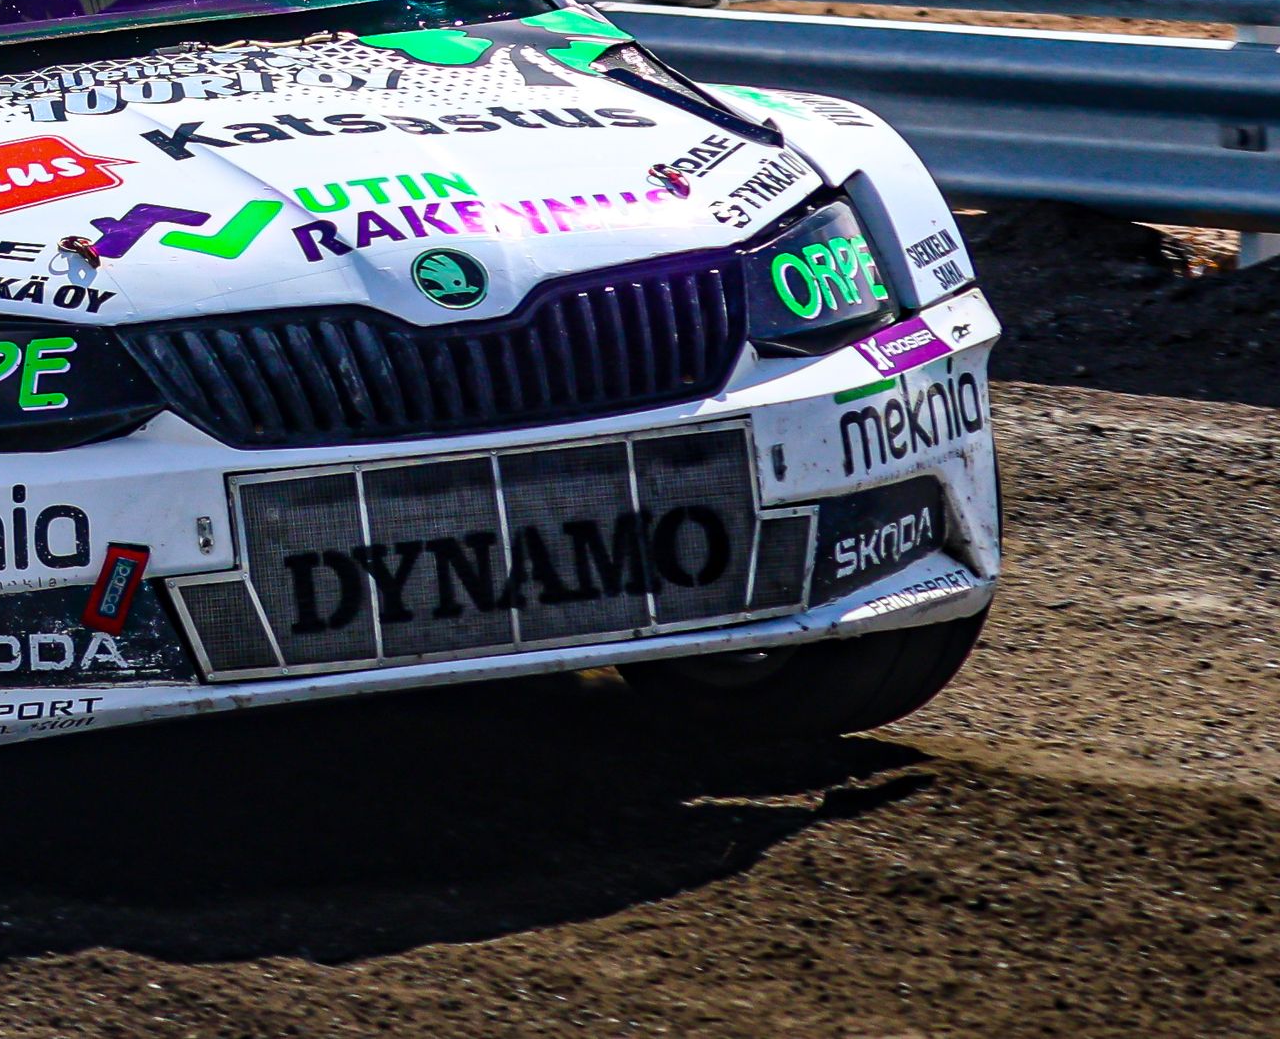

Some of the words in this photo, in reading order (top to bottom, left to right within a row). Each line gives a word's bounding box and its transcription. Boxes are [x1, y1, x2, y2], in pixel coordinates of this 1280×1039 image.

[140, 106, 657, 161] Katsastus
[293, 171, 479, 214] UTIN
[728, 158, 796, 209] TYKKÄ
[53, 284, 118, 314] OY
[770, 233, 888, 320] ORPE
[882, 330, 936, 358] HOOSIER
[840, 357, 983, 477] meknia
[284, 505, 730, 634] DYNAMO
